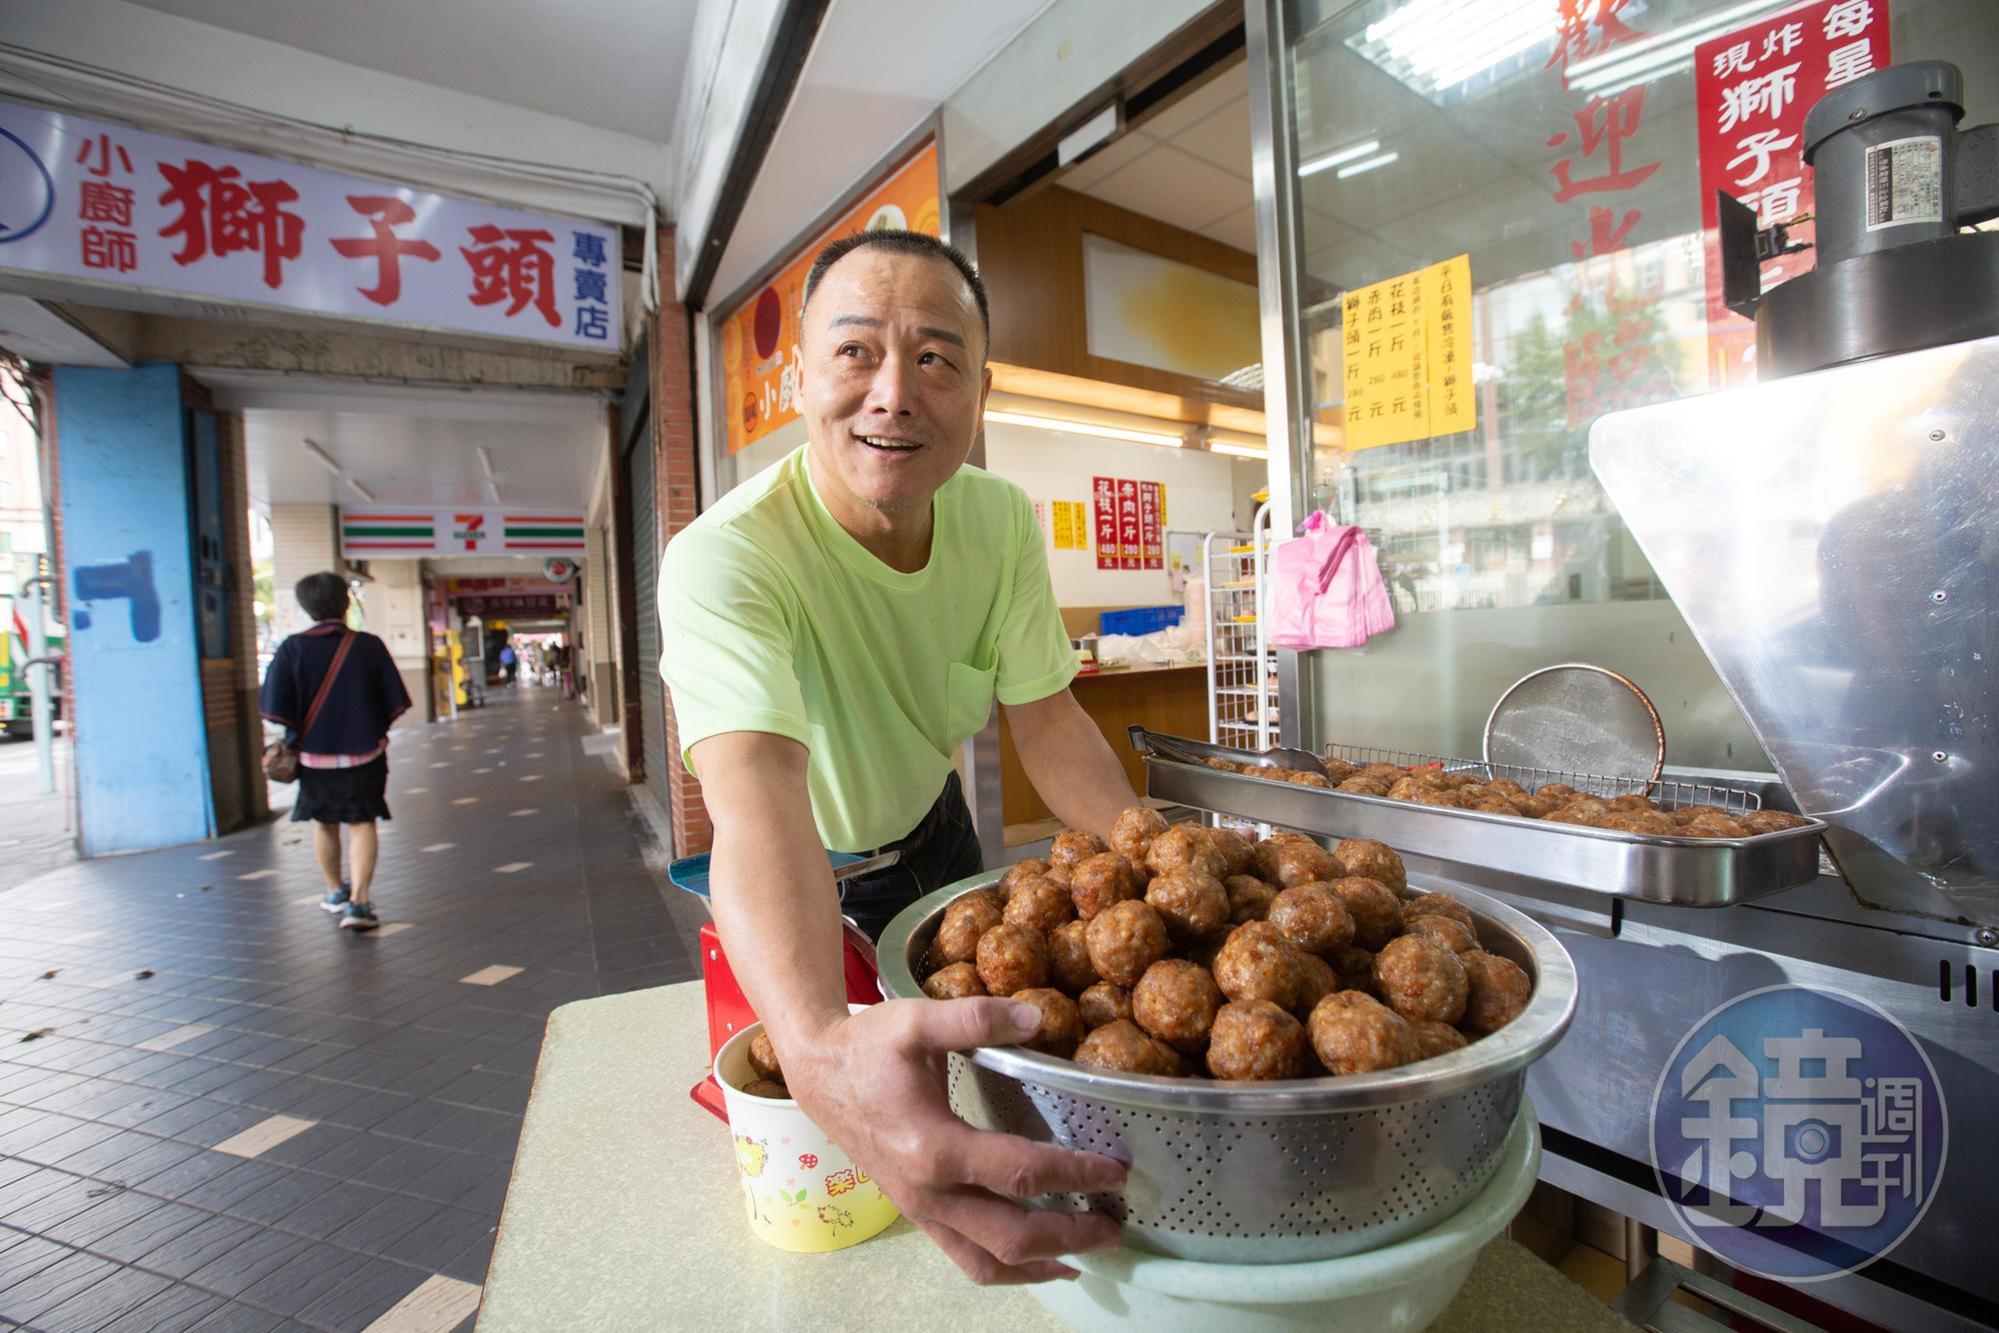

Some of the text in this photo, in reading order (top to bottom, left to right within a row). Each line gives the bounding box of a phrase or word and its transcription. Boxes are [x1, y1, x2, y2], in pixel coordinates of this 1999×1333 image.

[1713, 22, 1804, 80] 現炸
[75, 133, 138, 273] 小廚師
[156, 158, 563, 328] 獅子頭
[571, 230, 609, 340] 專賣店
